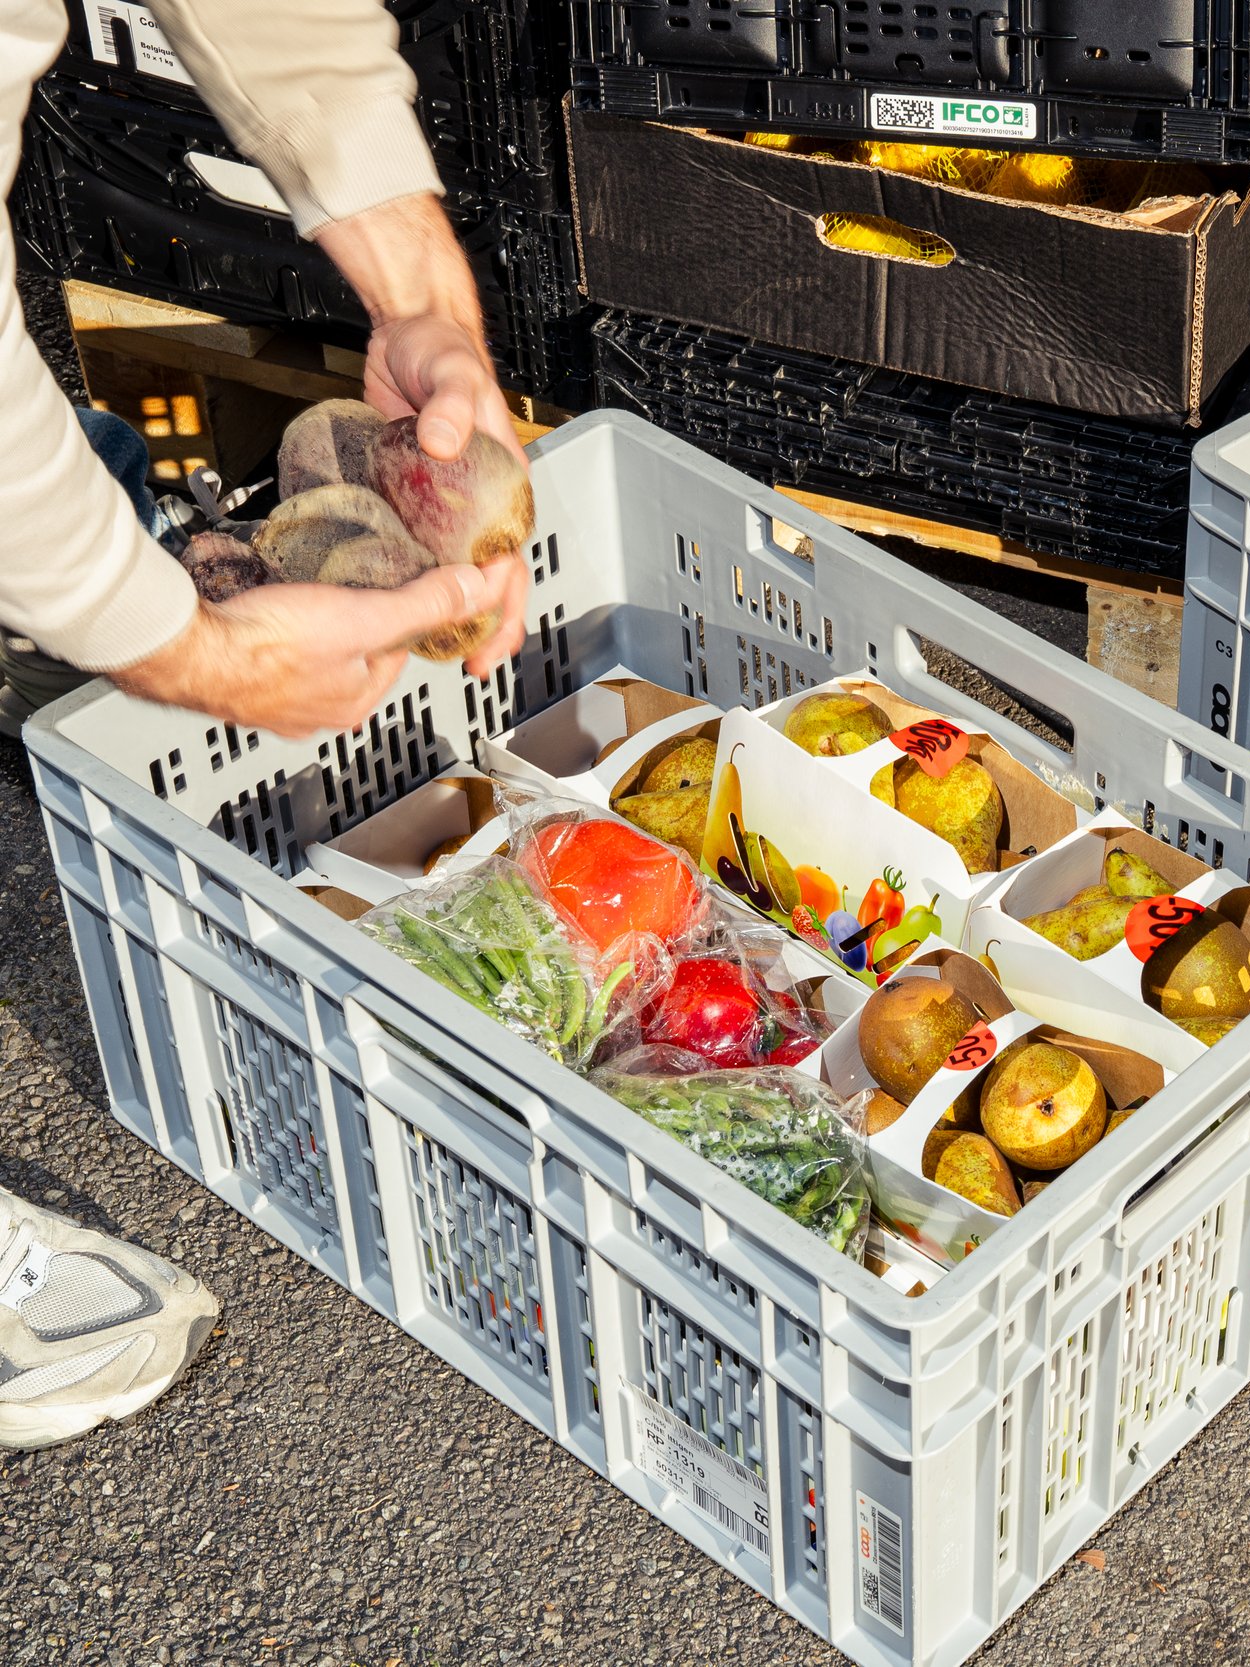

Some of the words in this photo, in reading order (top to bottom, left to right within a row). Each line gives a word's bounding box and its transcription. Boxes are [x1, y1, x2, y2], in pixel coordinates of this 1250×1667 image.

[942, 102, 1000, 124] IFCO
[1215, 639, 1233, 659] C3
[1148, 897, 1201, 952] -50
[646, 1429, 665, 1446] RP
[860, 1526, 871, 1559] coop
